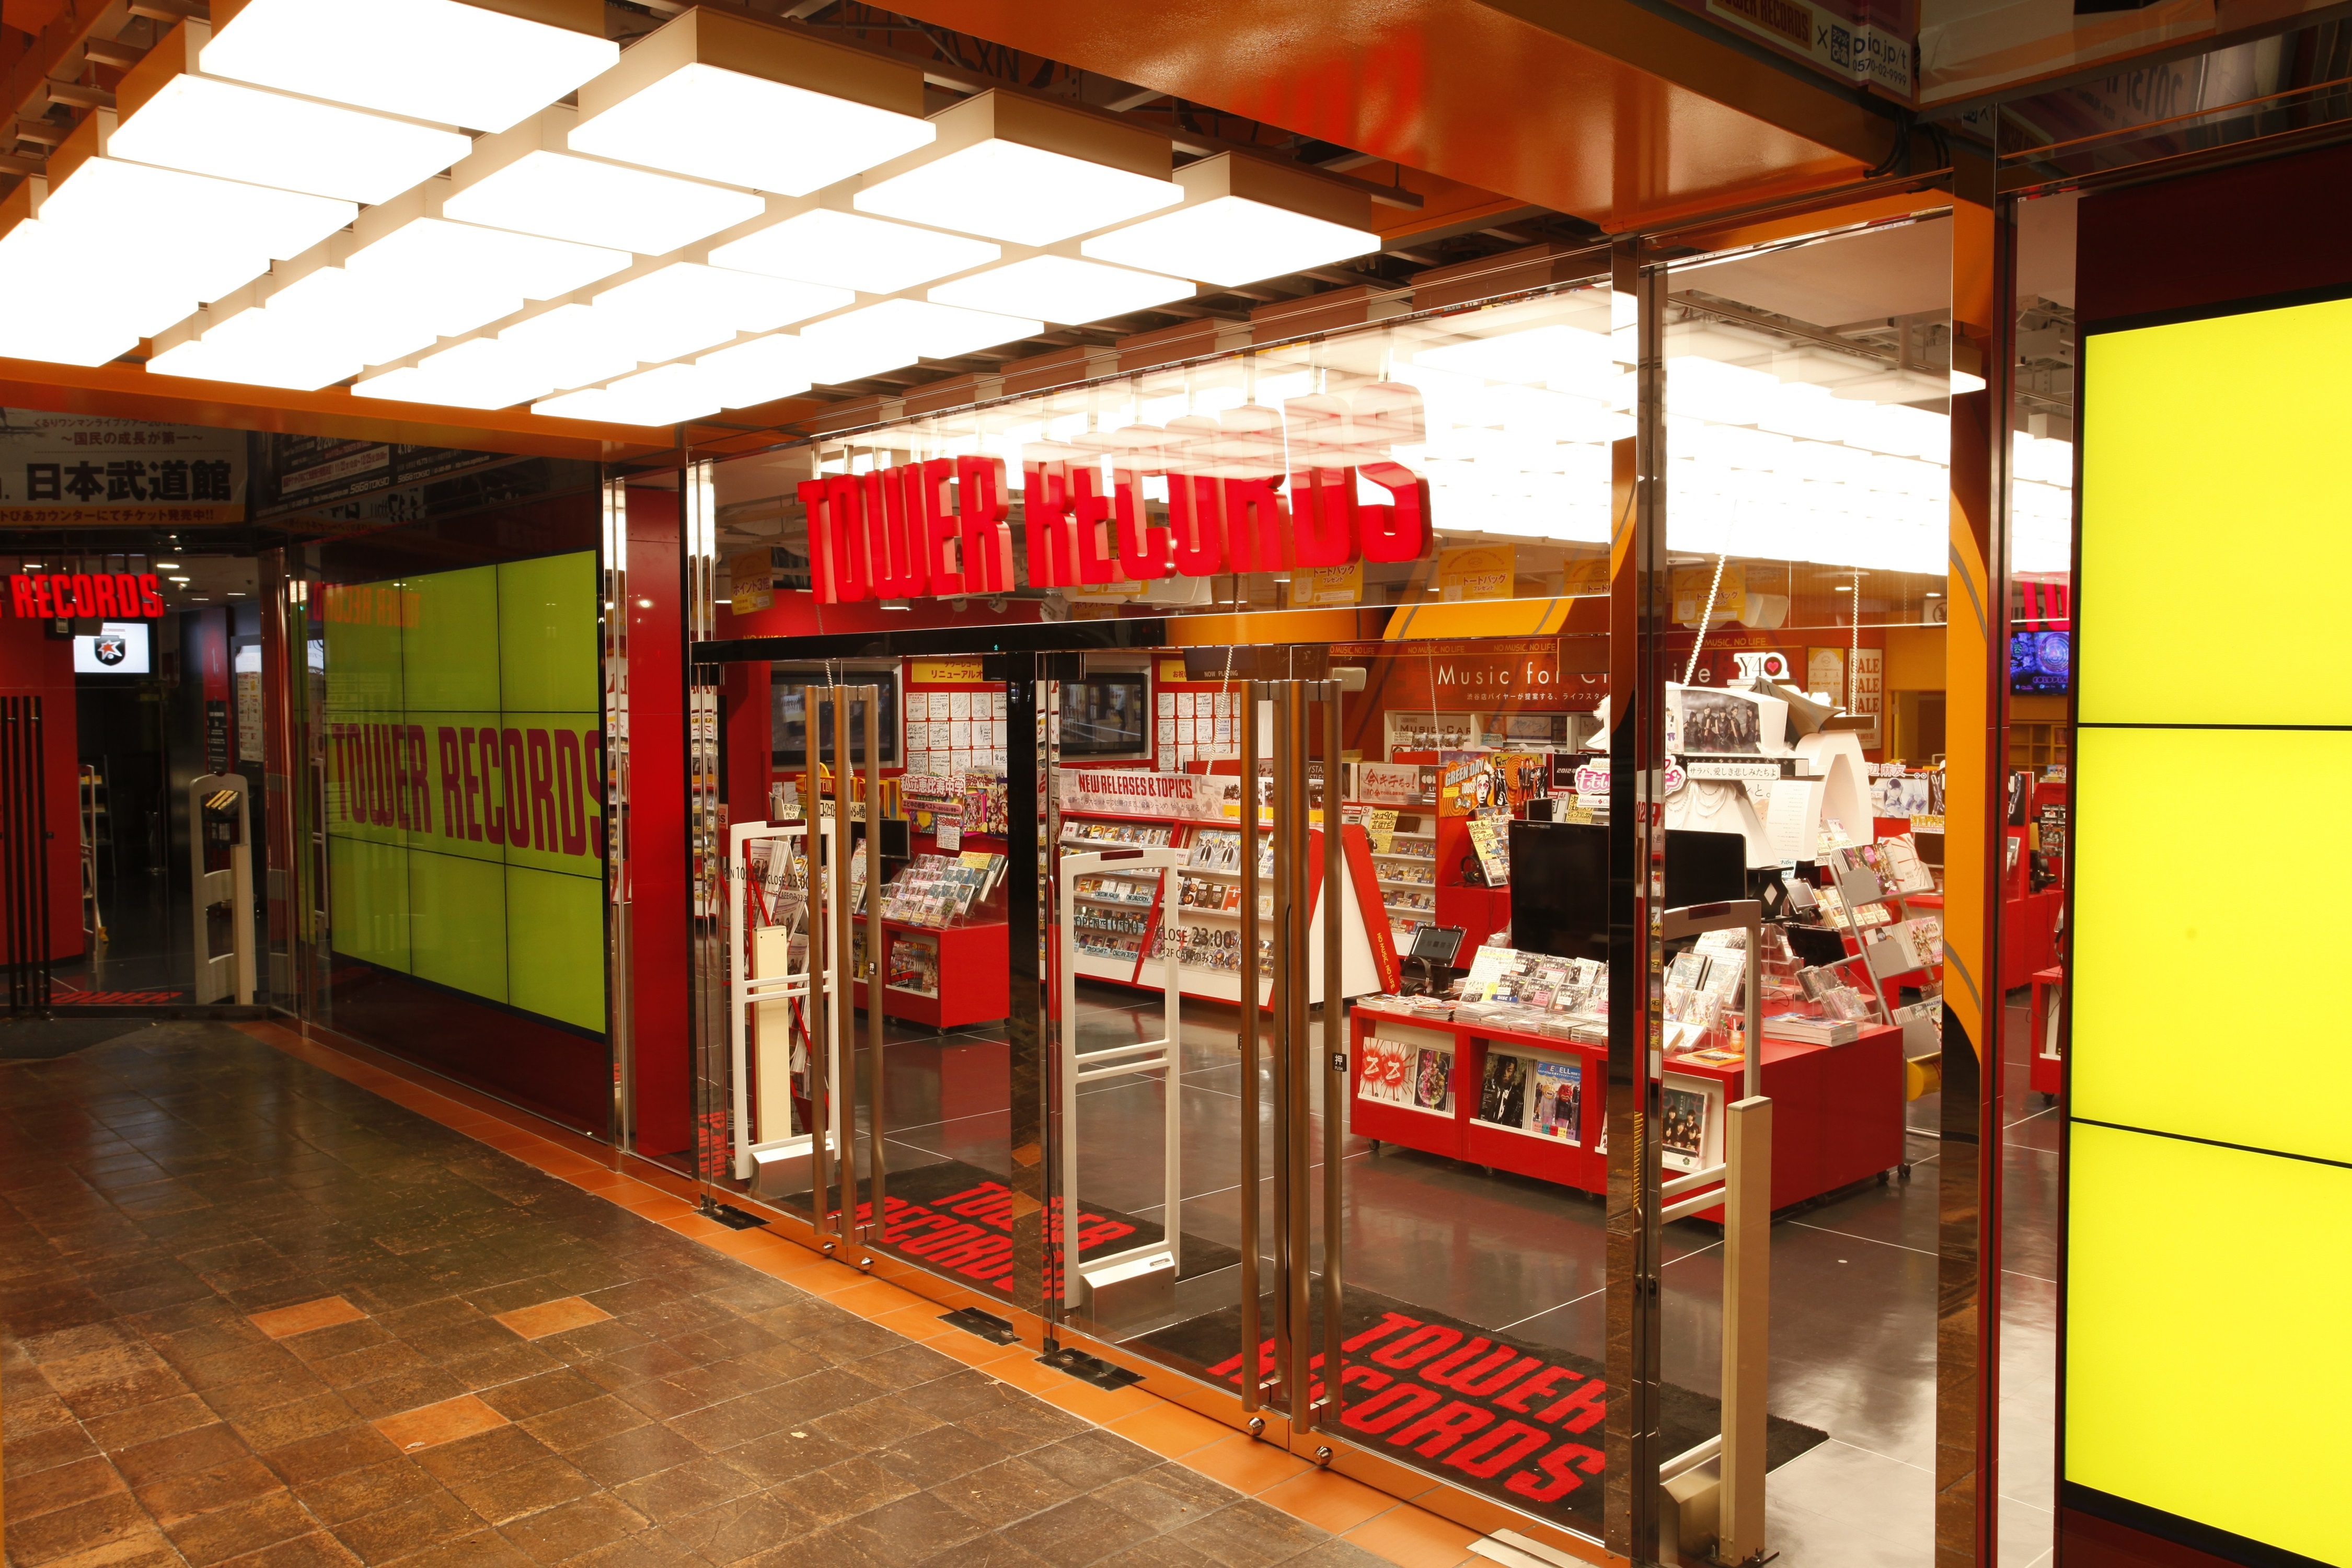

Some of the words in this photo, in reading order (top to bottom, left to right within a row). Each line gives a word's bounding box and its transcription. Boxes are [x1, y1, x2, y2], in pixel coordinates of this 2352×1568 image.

[1760, 0, 1808, 42] RECORDS
[1853, 31, 1907, 70] pia.jp/t
[1853, 58, 1907, 87] 0570-02-9999
[26, 459, 232, 502] 日本武道館
[797, 452, 1016, 605] TOWER
[1022, 382, 1434, 589] RECORDS
[1463, 573, 1507, 586] トートバッグ
[10, 573, 165, 618] RECORDS
[1697, 590, 1739, 602] トーバッグ
[1540, 643, 1558, 651] LIFE.
[1704, 638, 1732, 647] MUSIC,
[1734, 637, 1746, 645] NO
[1748, 637, 1768, 645] LIFE.
[1437, 664, 1509, 685] Music
[1400, 724, 1437, 734] MUSIC
[1445, 765, 1469, 787] GREEN
[1470, 758, 1485, 777] DAY
[1689, 765, 1778, 778] サラバ、愛しき悲しみたちよ
[331, 723, 433, 834] TOWER
[438, 726, 602, 859] RECORDS
[900, 775, 965, 798] 私立恵比寿中学
[1078, 774, 1100, 793] NEW
[1101, 775, 1147, 797] RELEASES
[1156, 777, 1193, 799] TOPICS
[767, 874, 787, 886] CLOSE
[1075, 916, 1100, 930] OPEN
[1156, 928, 1188, 943] CLOSE
[1192, 926, 1232, 949] 23:00
[1377, 932, 1383, 943] NO
[1379, 942, 1389, 965] MUSIC,
[1385, 964, 1392, 975] NO
[1334, 1054, 1343, 1066] 押
[929, 1180, 1136, 1252] TOER
[1341, 1311, 1606, 1435] TOWER
